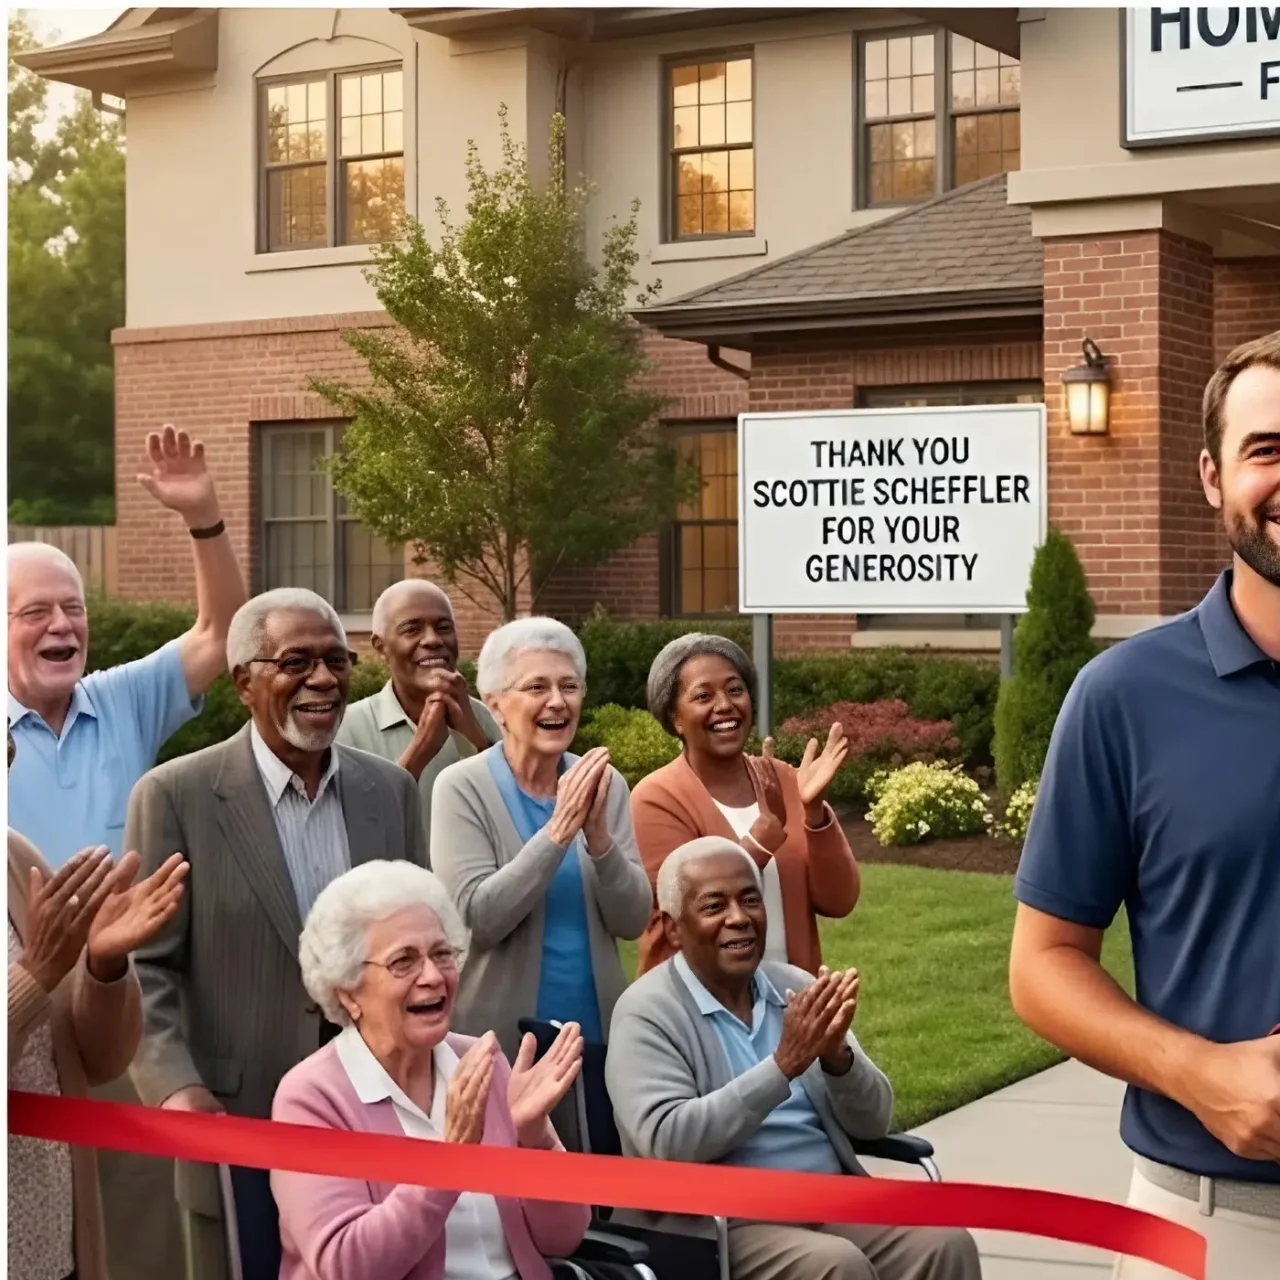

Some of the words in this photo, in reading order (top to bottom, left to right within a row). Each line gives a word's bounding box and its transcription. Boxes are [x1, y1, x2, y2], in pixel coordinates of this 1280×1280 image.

[810, 437, 905, 468] THANK
[912, 436, 970, 465] YOU
[753, 478, 866, 508] SCOTTIE
[873, 474, 1031, 505] SCHEFFLER
[822, 516, 876, 545] FOR
[883, 515, 961, 544] YOUR
[805, 553, 979, 583] GENEROSITY
